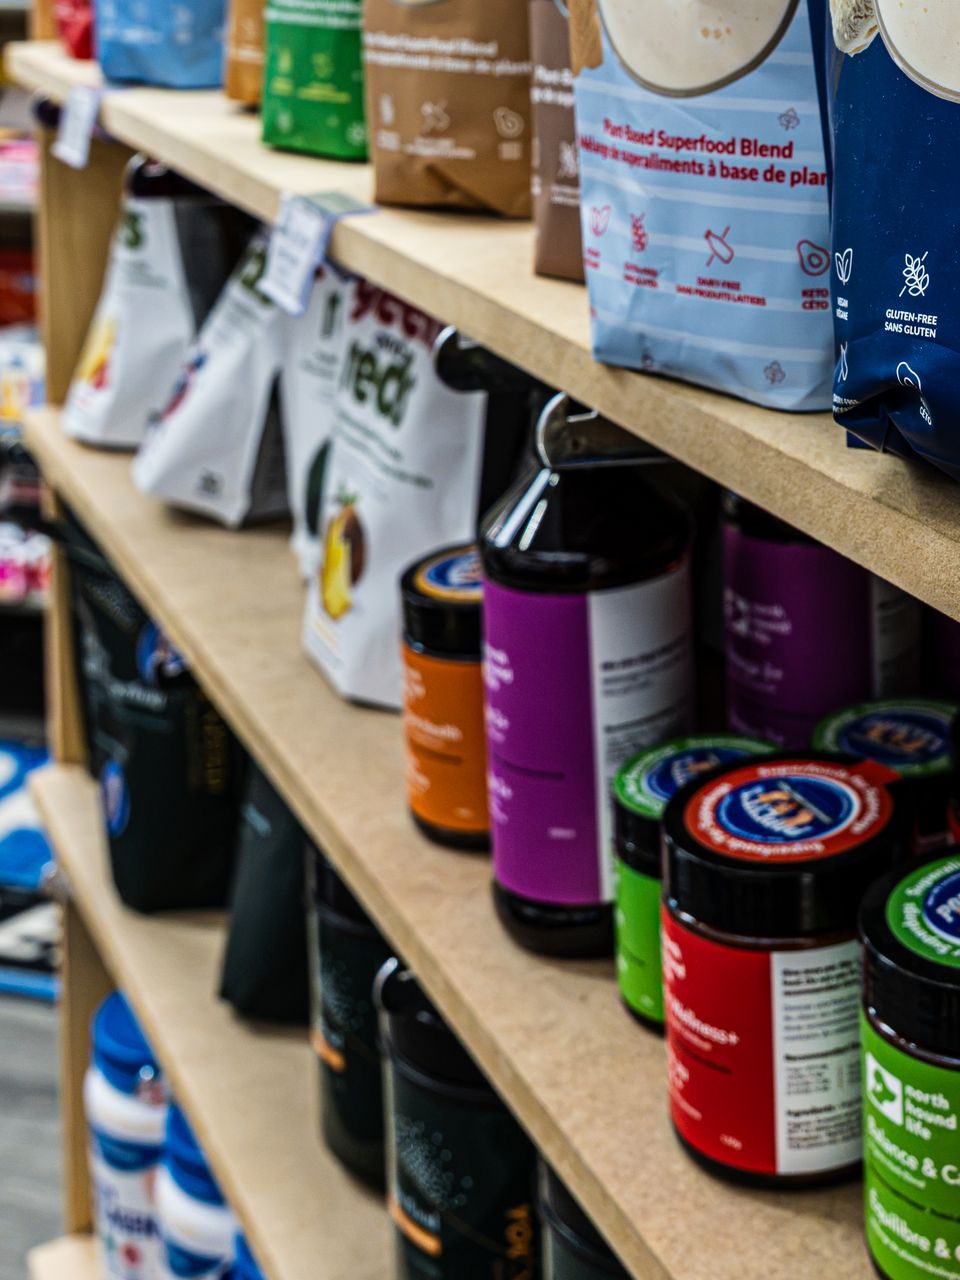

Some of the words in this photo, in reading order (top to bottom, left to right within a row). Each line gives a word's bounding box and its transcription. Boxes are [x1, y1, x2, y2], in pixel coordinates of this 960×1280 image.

[658, 130, 736, 154] Superfood
[740, 138, 794, 159] Blend
[707, 160, 717, 176] à
[719, 162, 759, 182] base
[762, 164, 785, 183] de
[885, 309, 938, 325] GLUTEN-FREE
[884, 321, 903, 334] SANS
[904, 325, 937, 338] GLUTEN
[905, 1085, 950, 1111] north
[905, 1098, 958, 1130] hound
[905, 1115, 932, 1141] life
[921, 1156, 938, 1180] &
[934, 1238, 951, 1260] &
